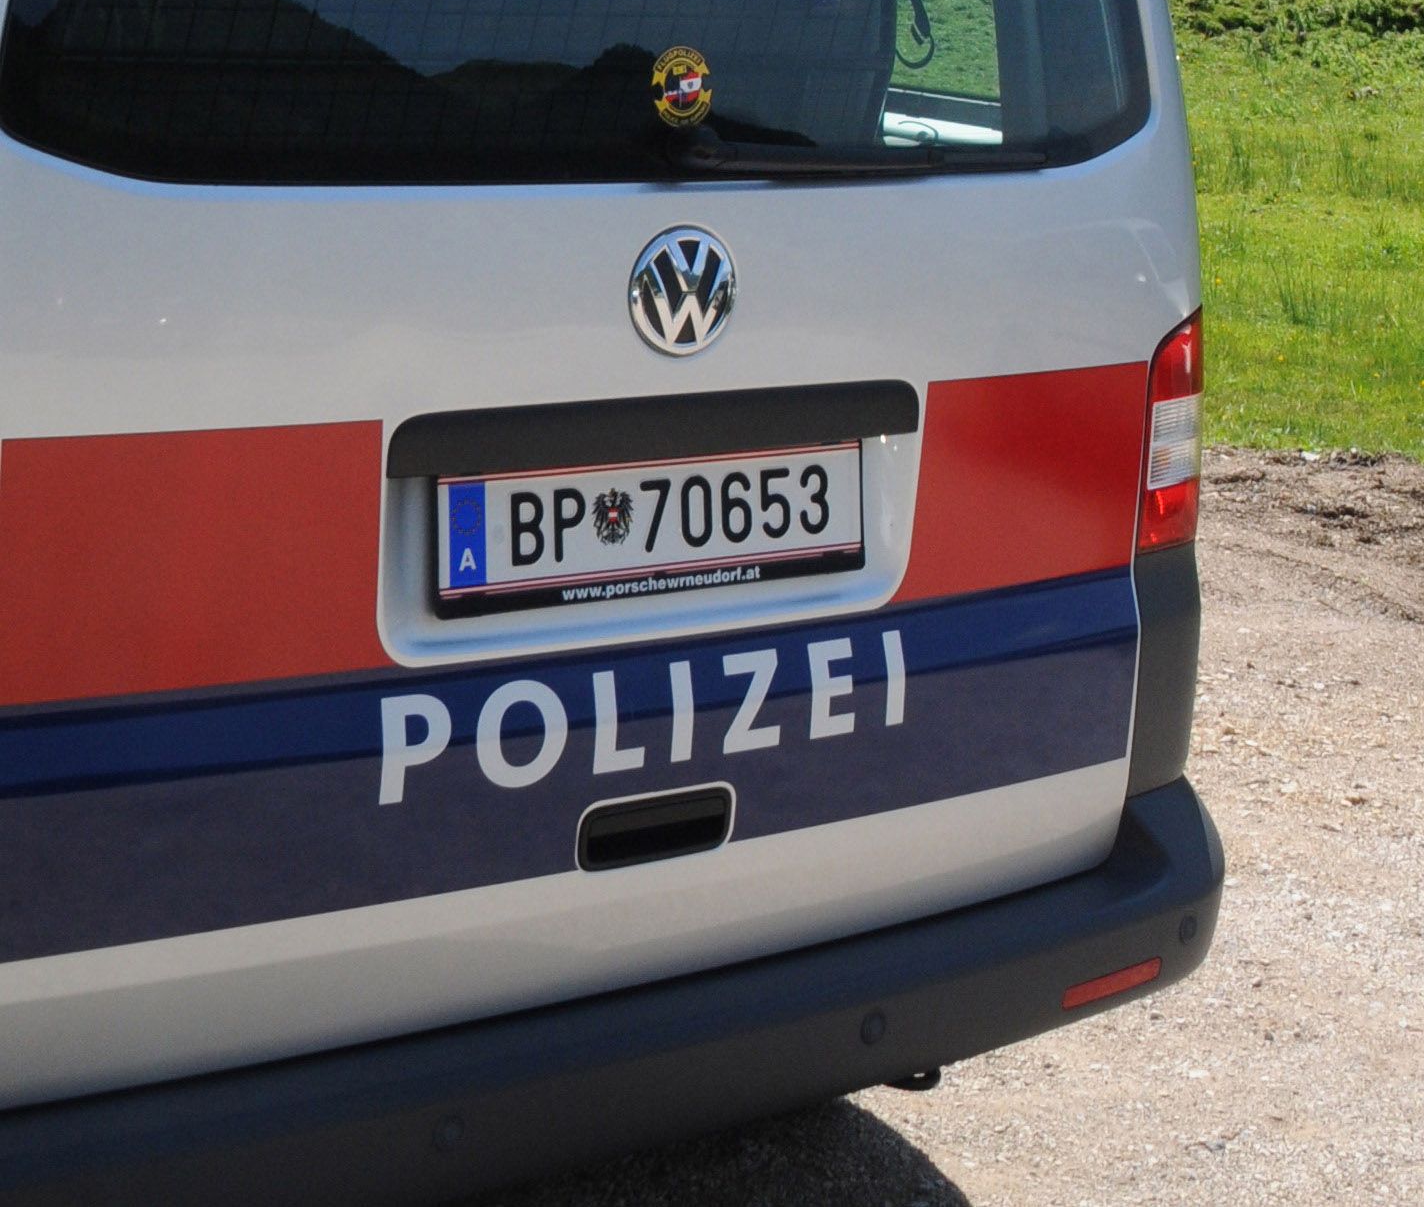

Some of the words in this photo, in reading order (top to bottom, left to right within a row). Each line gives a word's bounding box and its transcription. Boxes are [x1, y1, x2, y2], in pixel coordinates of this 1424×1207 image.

[632, 227, 733, 353] VW
[459, 548, 477, 571] A
[509, 487, 587, 567] BP
[638, 464, 830, 553] 70653
[561, 565, 761, 601] www.porschewrneudorf.at
[377, 629, 906, 806] POLIZEI
